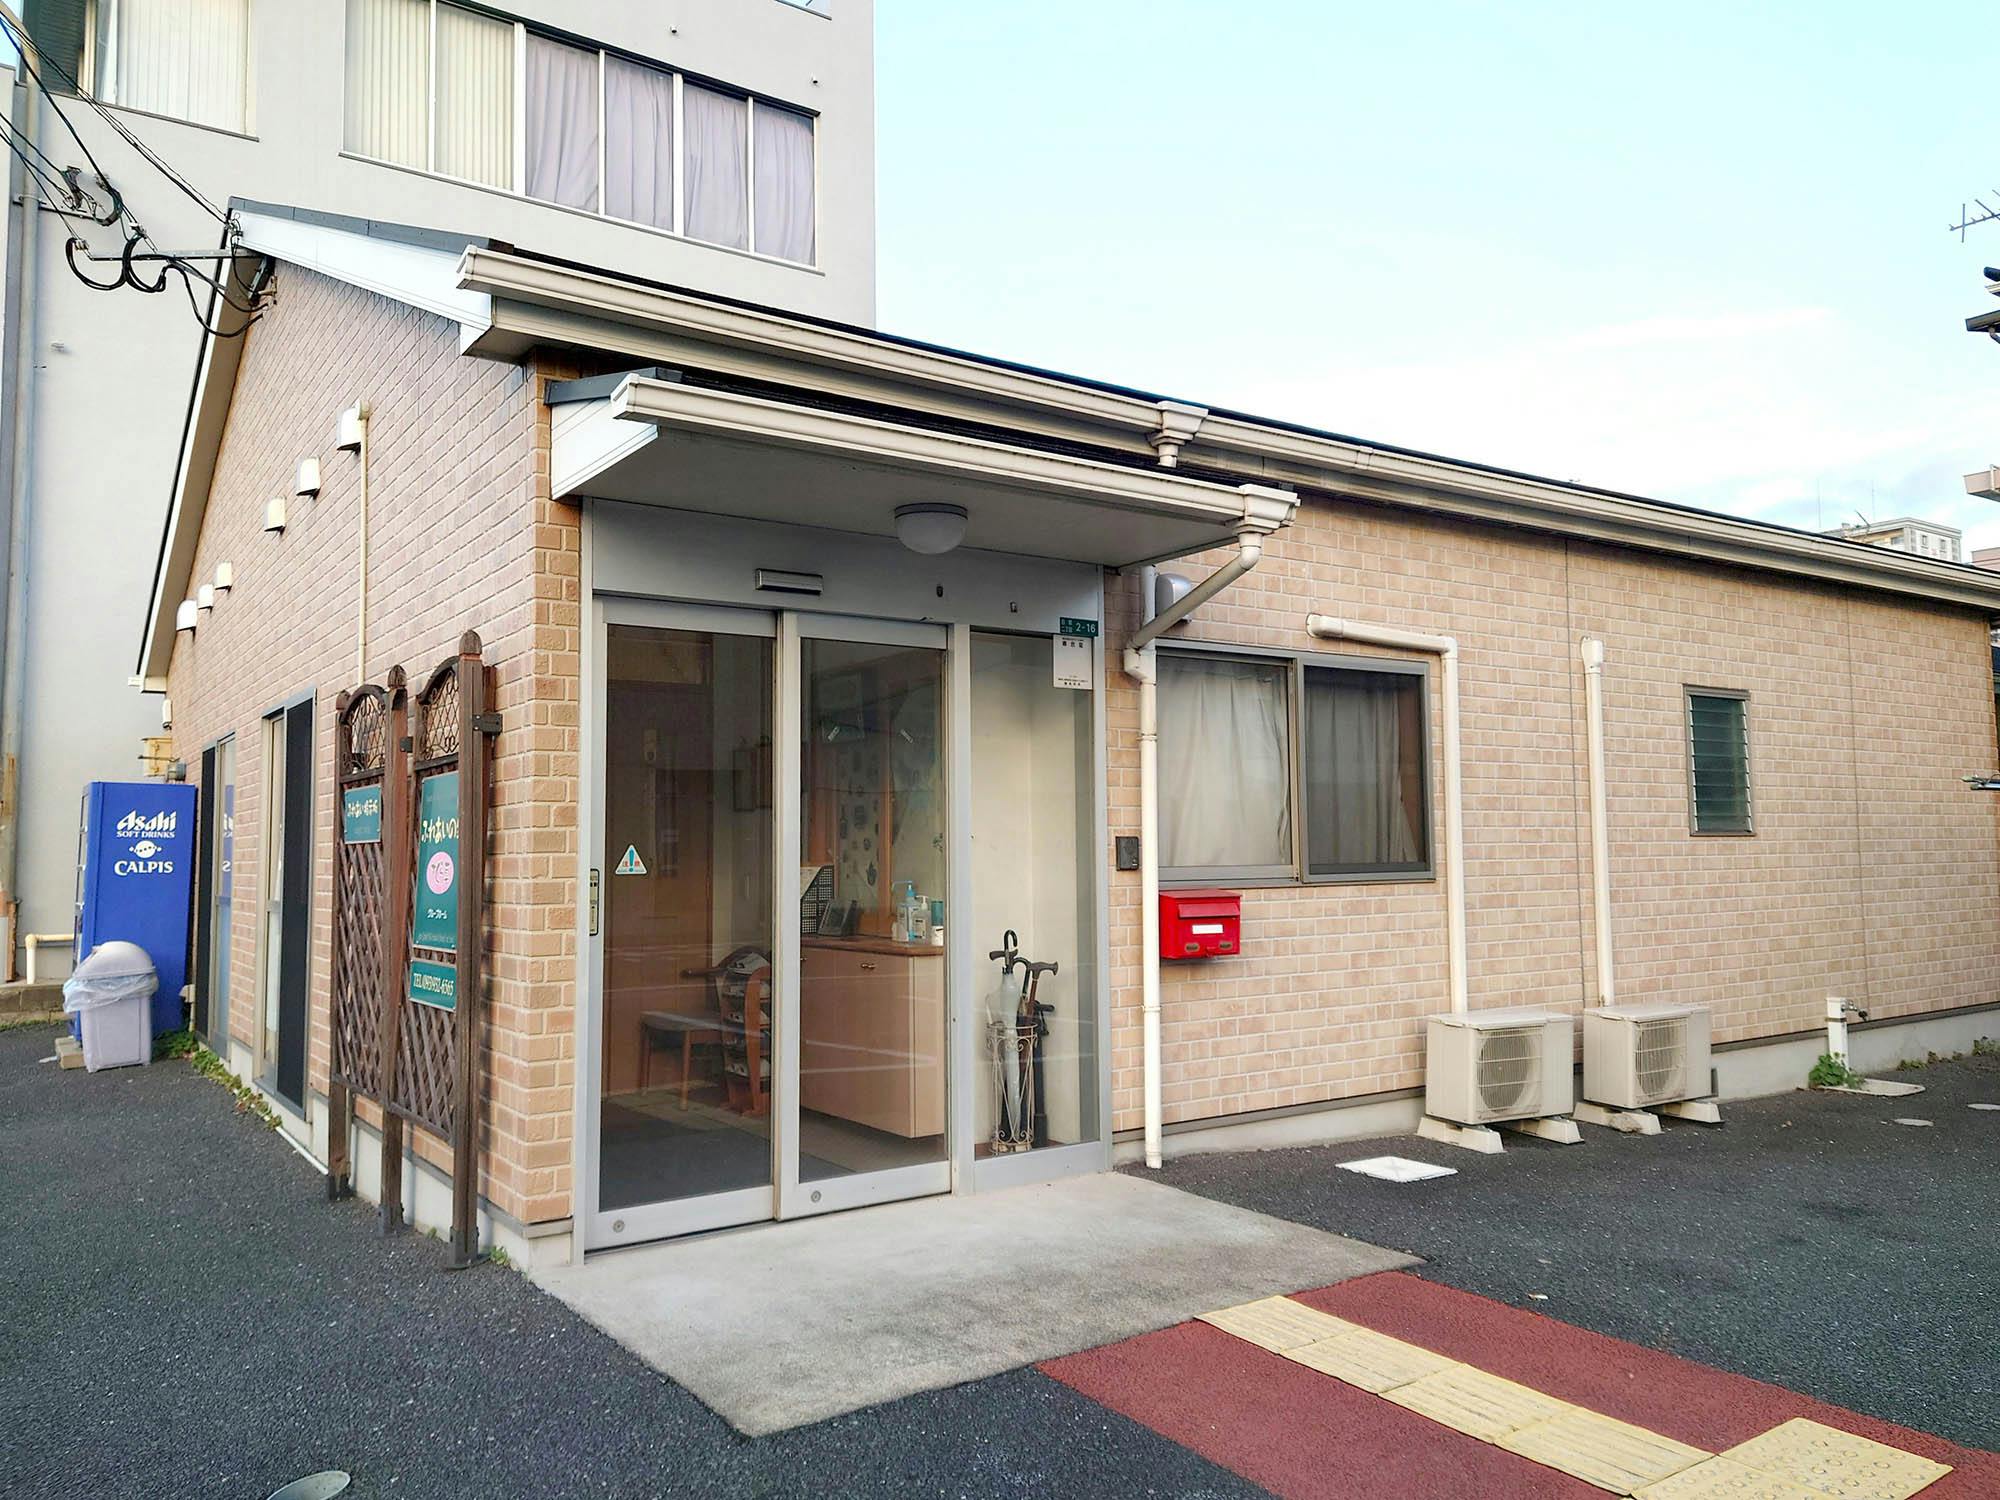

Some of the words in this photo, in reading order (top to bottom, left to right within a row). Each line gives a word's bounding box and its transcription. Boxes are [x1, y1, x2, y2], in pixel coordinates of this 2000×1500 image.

[1075, 622, 1096, 633] 2-16
[116, 809, 177, 831] Asahi
[114, 860, 174, 877] CALPIS
